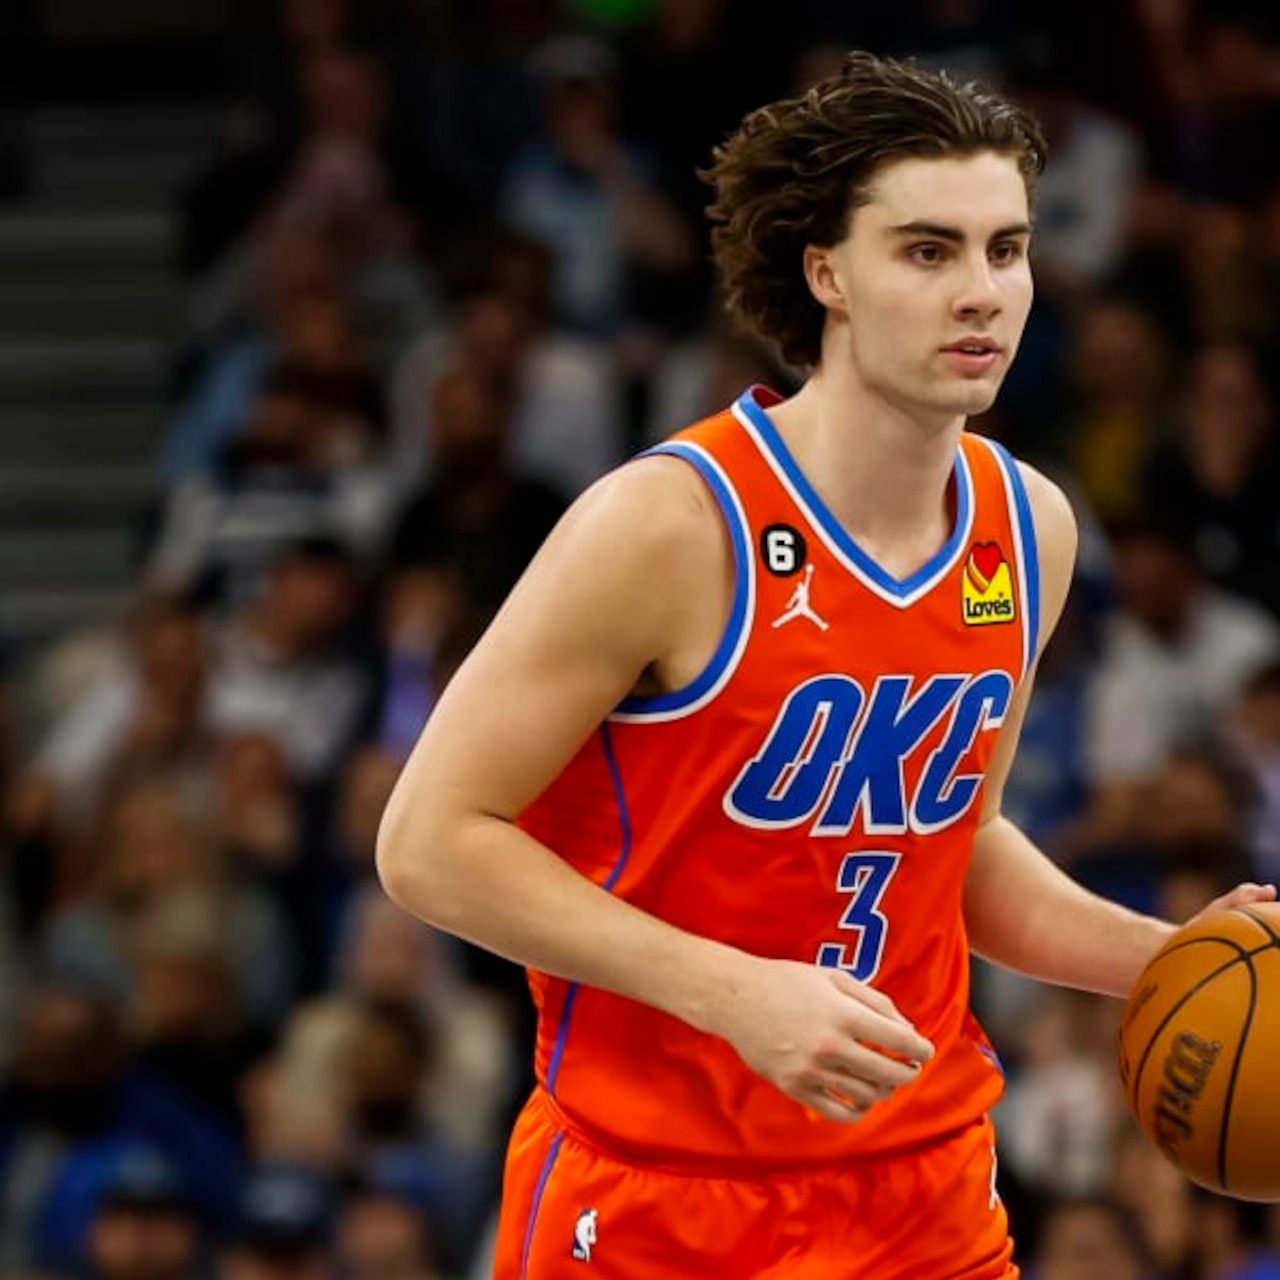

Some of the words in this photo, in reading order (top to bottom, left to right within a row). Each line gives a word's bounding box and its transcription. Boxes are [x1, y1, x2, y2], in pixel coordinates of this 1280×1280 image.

[766, 530, 795, 571] 6
[966, 592, 1012, 617] Love's
[722, 669, 1014, 837] OKC
[816, 850, 903, 986] 3
